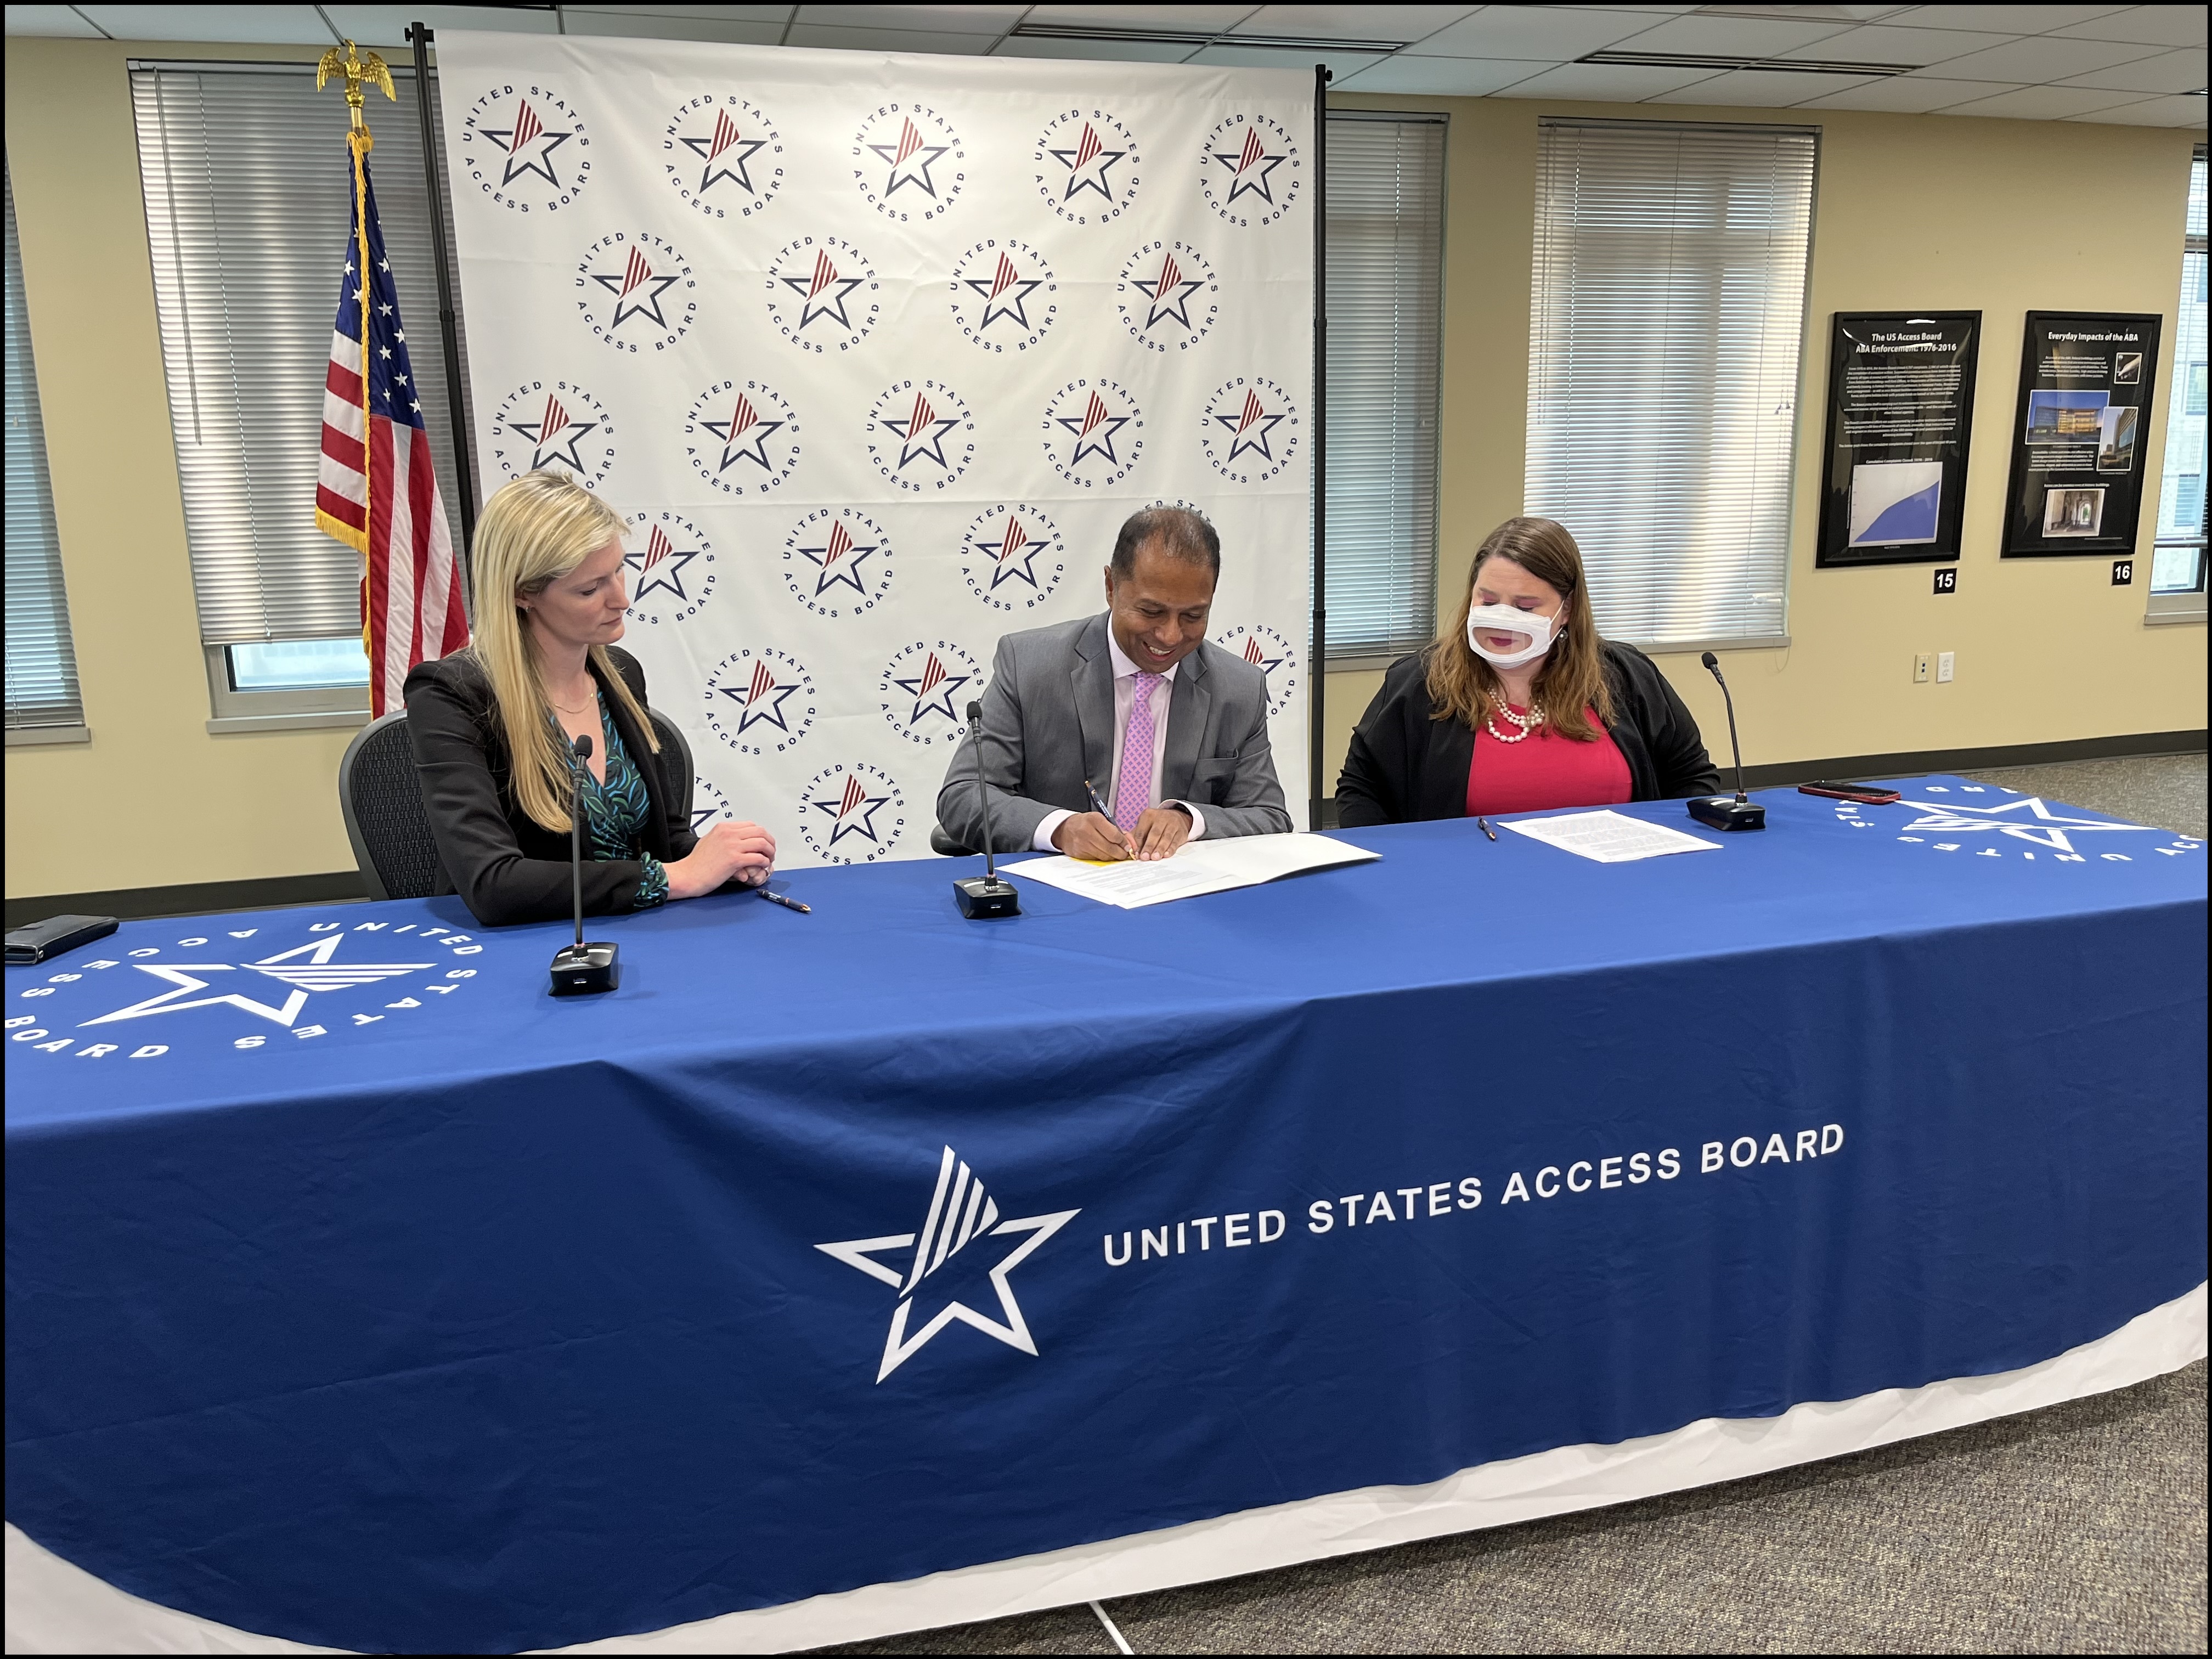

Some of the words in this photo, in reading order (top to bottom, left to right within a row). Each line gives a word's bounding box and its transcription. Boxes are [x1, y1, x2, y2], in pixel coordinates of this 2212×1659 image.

[462, 85, 513, 142] UNITED
[531, 86, 589, 146] STATES
[663, 95, 713, 149] UNITED
[729, 96, 783, 153] STATES
[853, 103, 899, 155] UNITED
[913, 104, 964, 159] STATES
[1034, 109, 1079, 161] UNITED
[1093, 110, 1140, 163] STATES
[1200, 114, 1244, 165] UNITED
[1257, 115, 1300, 167] STATES
[465, 157, 529, 212] ACCESS
[548, 161, 590, 211] BOARD
[665, 164, 724, 218] ACCESS
[742, 168, 783, 217] BOARD
[854, 170, 908, 222] ACCESS
[924, 173, 964, 220] BOARD
[1035, 174, 1086, 225] ACCESS
[1101, 177, 1139, 223] BOARD
[1200, 178, 1247, 227] ACCESS
[1262, 180, 1299, 225] BOARD
[575, 232, 624, 287] UNITED
[640, 233, 696, 288] STATES
[766, 236, 812, 289] UNITED
[828, 236, 879, 290] STATES
[950, 239, 995, 291] UNITED
[1009, 239, 1057, 292] STATES
[1117, 241, 1161, 292] UNITED
[1175, 241, 1218, 292] STATES
[577, 301, 637, 353] ACCESS
[654, 302, 696, 351] BOARD
[767, 303, 822, 353] ACCESS
[839, 304, 879, 351] BOARD
[951, 304, 1002, 353] ACCESS
[1018, 305, 1057, 351] BOARD
[1118, 305, 1165, 352] ACCESS
[1180, 305, 1218, 350] BOARD
[1855, 344, 1870, 353] ABA
[1871, 333, 1885, 341] The
[1886, 333, 1897, 341] US
[1897, 332, 1920, 341] Access
[1921, 332, 1942, 341] Board
[2048, 331, 2078, 342] Everyday
[2078, 332, 2104, 342] Impacts
[2104, 332, 2112, 341] of
[2112, 333, 2123, 341] the
[2124, 333, 2138, 341] ABA
[493, 381, 541, 436] UNITED
[558, 381, 614, 435] STATES
[685, 381, 732, 433] UNITED
[747, 380, 800, 433] STATES
[866, 380, 912, 432] UNITED
[926, 380, 974, 431] STATES
[1042, 379, 1086, 429] UNITED
[1100, 379, 1143, 428] STATES
[1201, 377, 1244, 426] UNITED
[1256, 377, 1299, 425] STATES
[585, 448, 614, 489] OARD
[686, 447, 743, 495] ACCESS
[760, 446, 800, 493] BOARD
[867, 445, 920, 492] ACCESS
[936, 443, 974, 489] BOARD
[1043, 442, 1091, 488] ACCESS
[1106, 441, 1143, 486] BOARD
[1201, 439, 1247, 483] ACCESS
[1261, 437, 1297, 481] BOARD
[662, 512, 715, 562] STATES
[783, 509, 828, 560] UNITED
[843, 508, 893, 557] STATES
[961, 504, 1005, 555] UNITED
[1018, 504, 1064, 551] STATES
[784, 573, 838, 618] ACCESS
[854, 570, 893, 615] BOARD
[962, 567, 1011, 611] ACCESS
[1026, 564, 1064, 608] BOARD
[1937, 573, 1954, 588] 15
[2115, 565, 2131, 579] 16
[625, 607, 658, 624] ESS
[675, 575, 715, 622] BOARD
[879, 641, 924, 691] UNITED
[938, 640, 984, 686] STATES
[1217, 626, 1244, 645] TED
[1256, 625, 1295, 668] STATES
[704, 649, 751, 699] UNITED
[765, 648, 815, 695] STATES
[1271, 680, 1295, 715] OARD
[706, 713, 760, 755] ACCESS
[777, 707, 816, 752] BOARD
[881, 703, 931, 744] ACCESS
[696, 776, 732, 819] TATES
[798, 764, 843, 813] UNITED
[857, 763, 904, 806] STATES
[799, 826, 851, 865] ACCESS
[867, 818, 904, 862] BOARD
[1897, 837, 2132, 862] UNITED
[21, 928, 258, 997] ACCESS
[309, 922, 483, 955] UNITED
[234, 969, 477, 1049] STATES
[5, 1015, 169, 1058] BOARD
[1104, 1210, 1285, 1266] UNITED
[1308, 1177, 1482, 1234] STATES
[1500, 1148, 1680, 1204] ACCESS
[1701, 1124, 1844, 1173] BOARD
